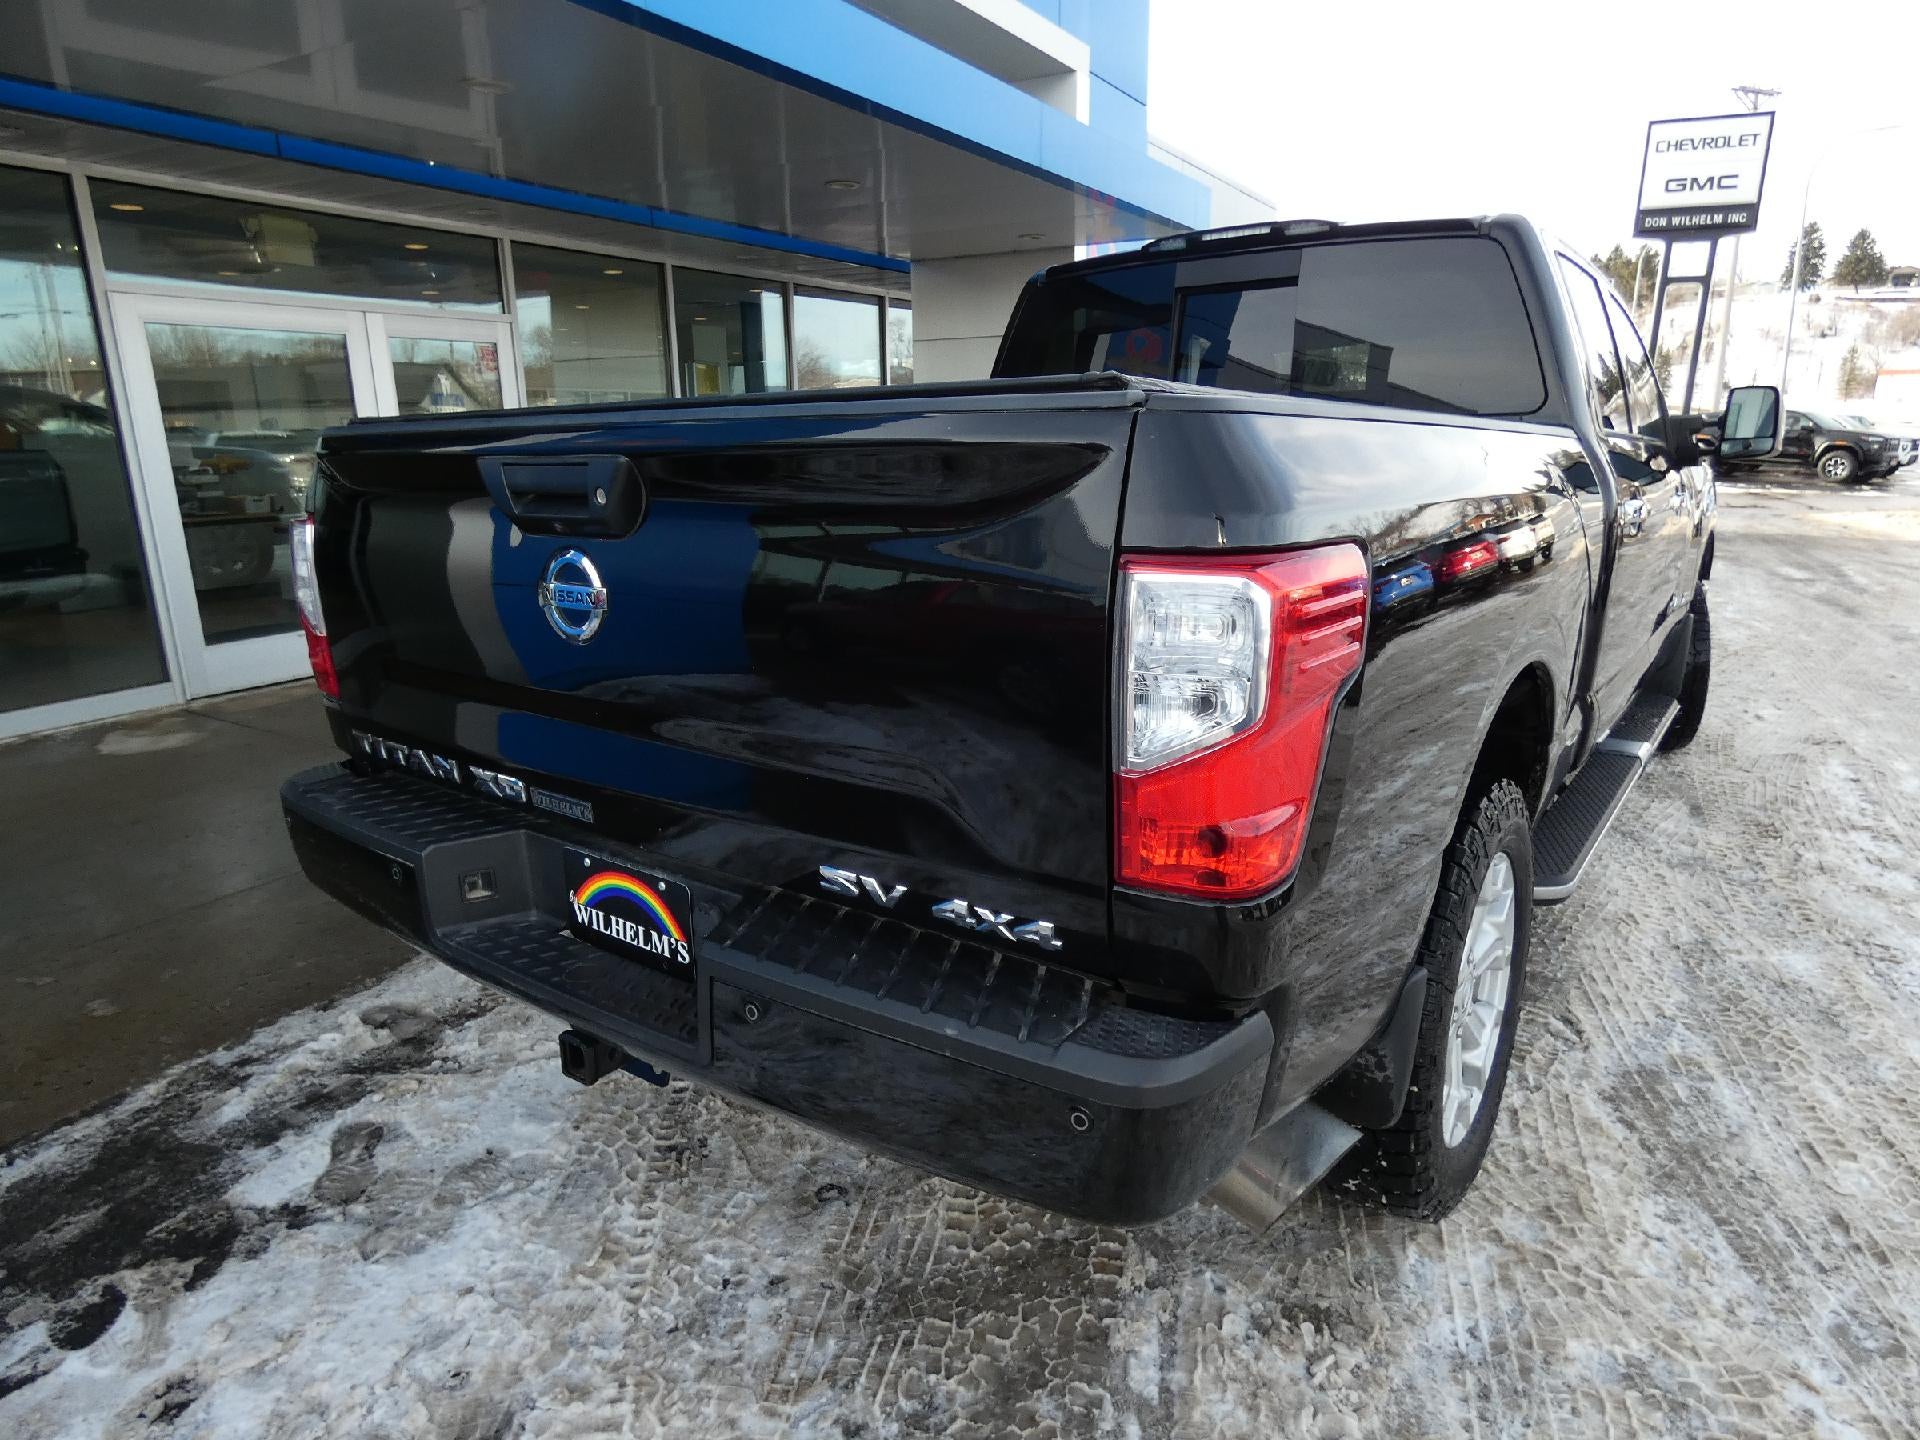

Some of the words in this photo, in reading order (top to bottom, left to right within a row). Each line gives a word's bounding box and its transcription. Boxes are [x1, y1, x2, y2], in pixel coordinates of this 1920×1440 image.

[1655, 133, 1761, 153] CHEVROLET
[1664, 174, 1739, 193] GMC
[1644, 216, 1667, 227] DON
[1671, 213, 1723, 226] WILHELM
[1727, 212, 1747, 223] INC
[543, 584, 596, 607] NISSAN
[351, 728, 462, 784] TITAN
[819, 865, 909, 909] SV
[573, 901, 691, 965] WILHELM'S
